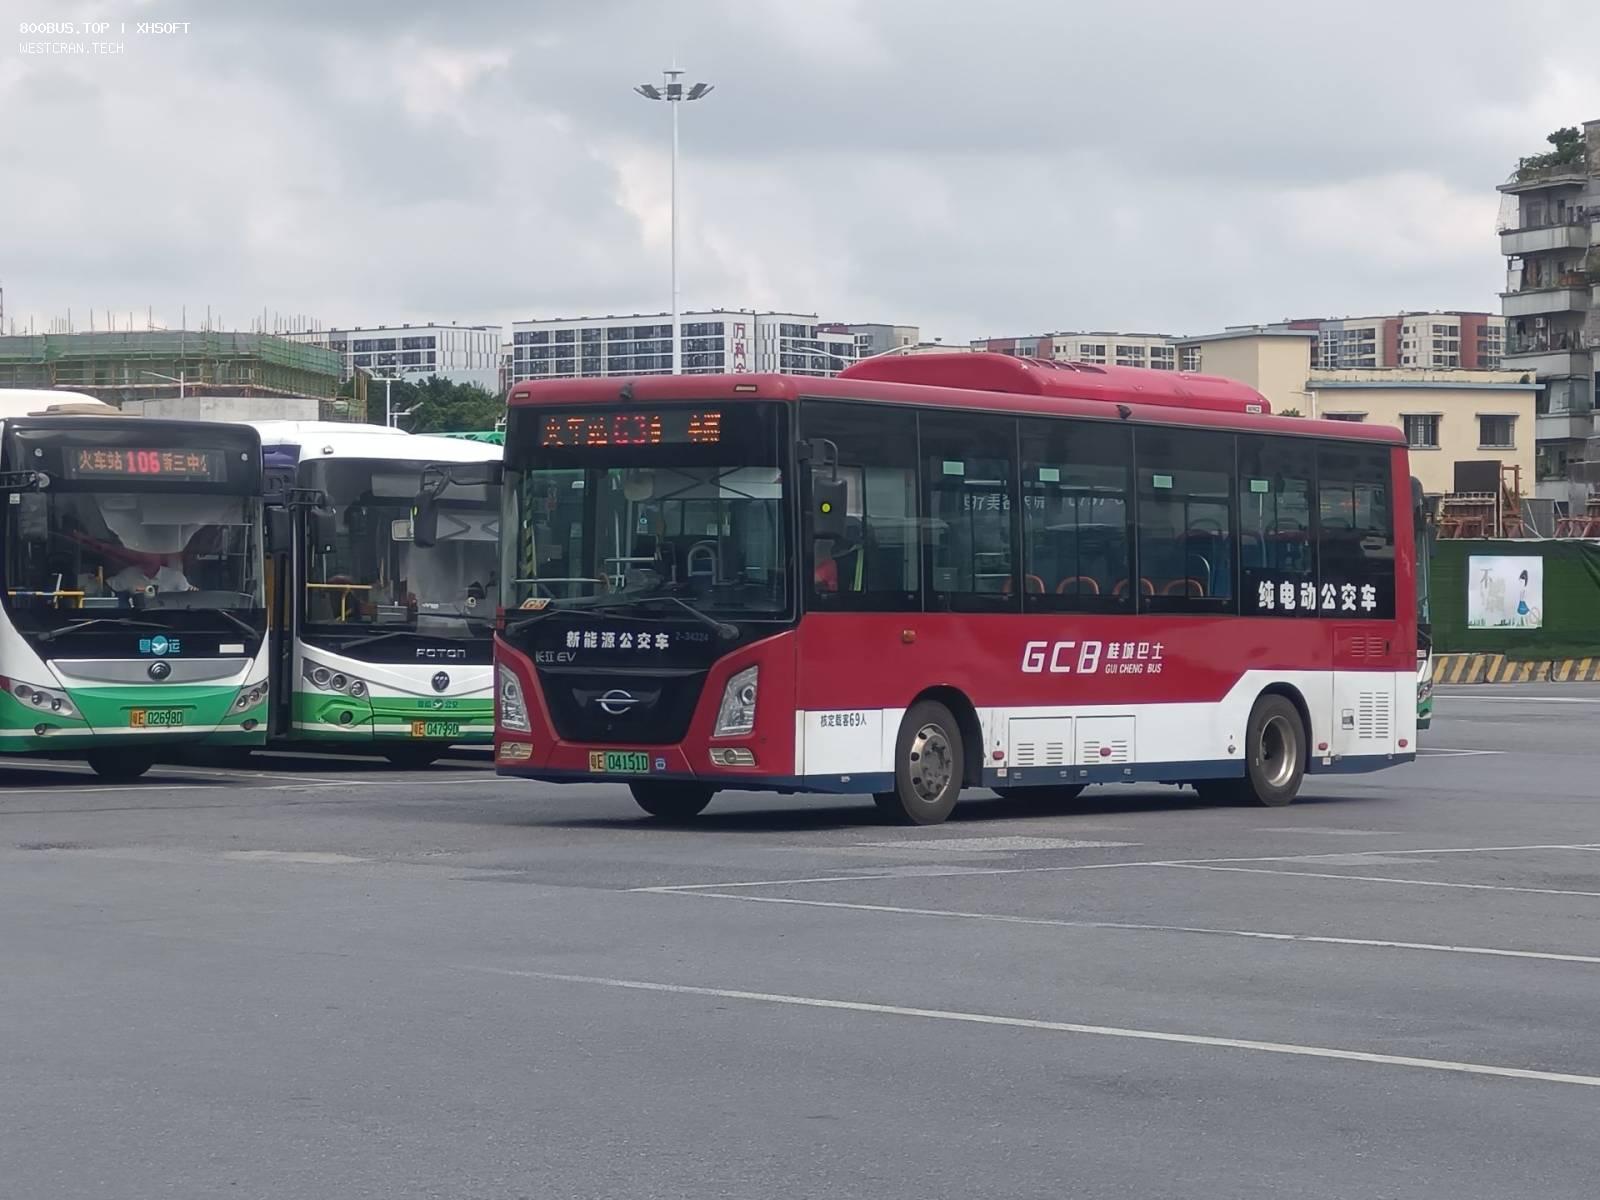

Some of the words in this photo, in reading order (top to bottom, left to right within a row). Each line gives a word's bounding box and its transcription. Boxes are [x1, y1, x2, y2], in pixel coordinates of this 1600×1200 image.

[127, 450, 161, 473] 106
[1258, 580, 1377, 611] 纯电动公交车
[566, 631, 669, 650] 新能源公交车
[1106, 642, 1165, 660] 桂城巴士
[1021, 641, 1103, 674] GCB
[1105, 664, 1118, 674] GUI
[1119, 664, 1143, 674] CHENG
[1147, 664, 1162, 674] BUS
